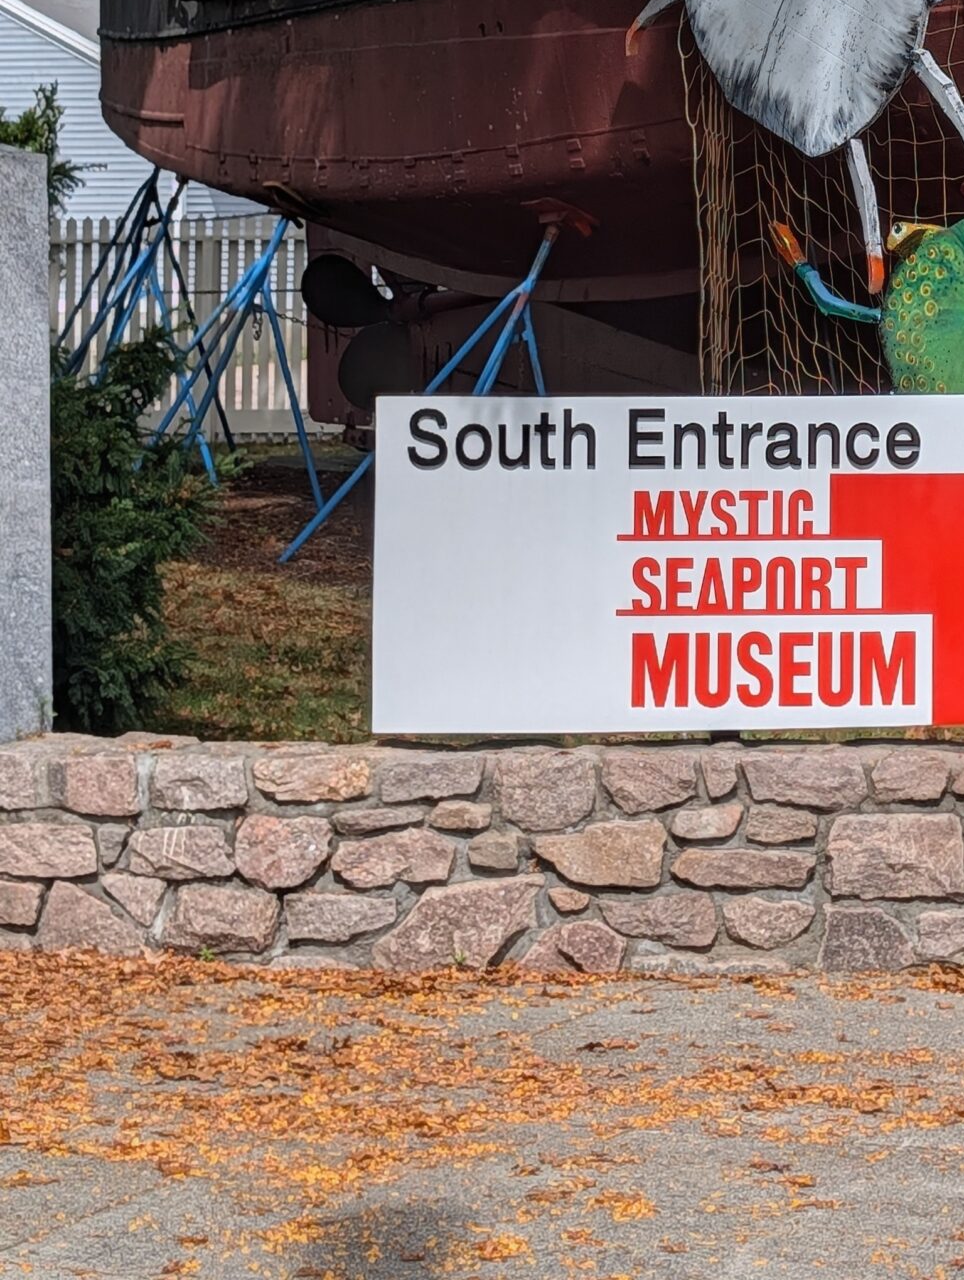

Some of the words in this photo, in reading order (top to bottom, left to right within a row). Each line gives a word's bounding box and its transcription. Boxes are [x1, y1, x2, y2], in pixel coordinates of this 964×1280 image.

[408, 408, 596, 469] South
[628, 408, 921, 469] Entrance
[633, 489, 814, 536] MYSTIC
[632, 556, 868, 610] SEAPORT
[632, 631, 917, 708] MUSEUM
